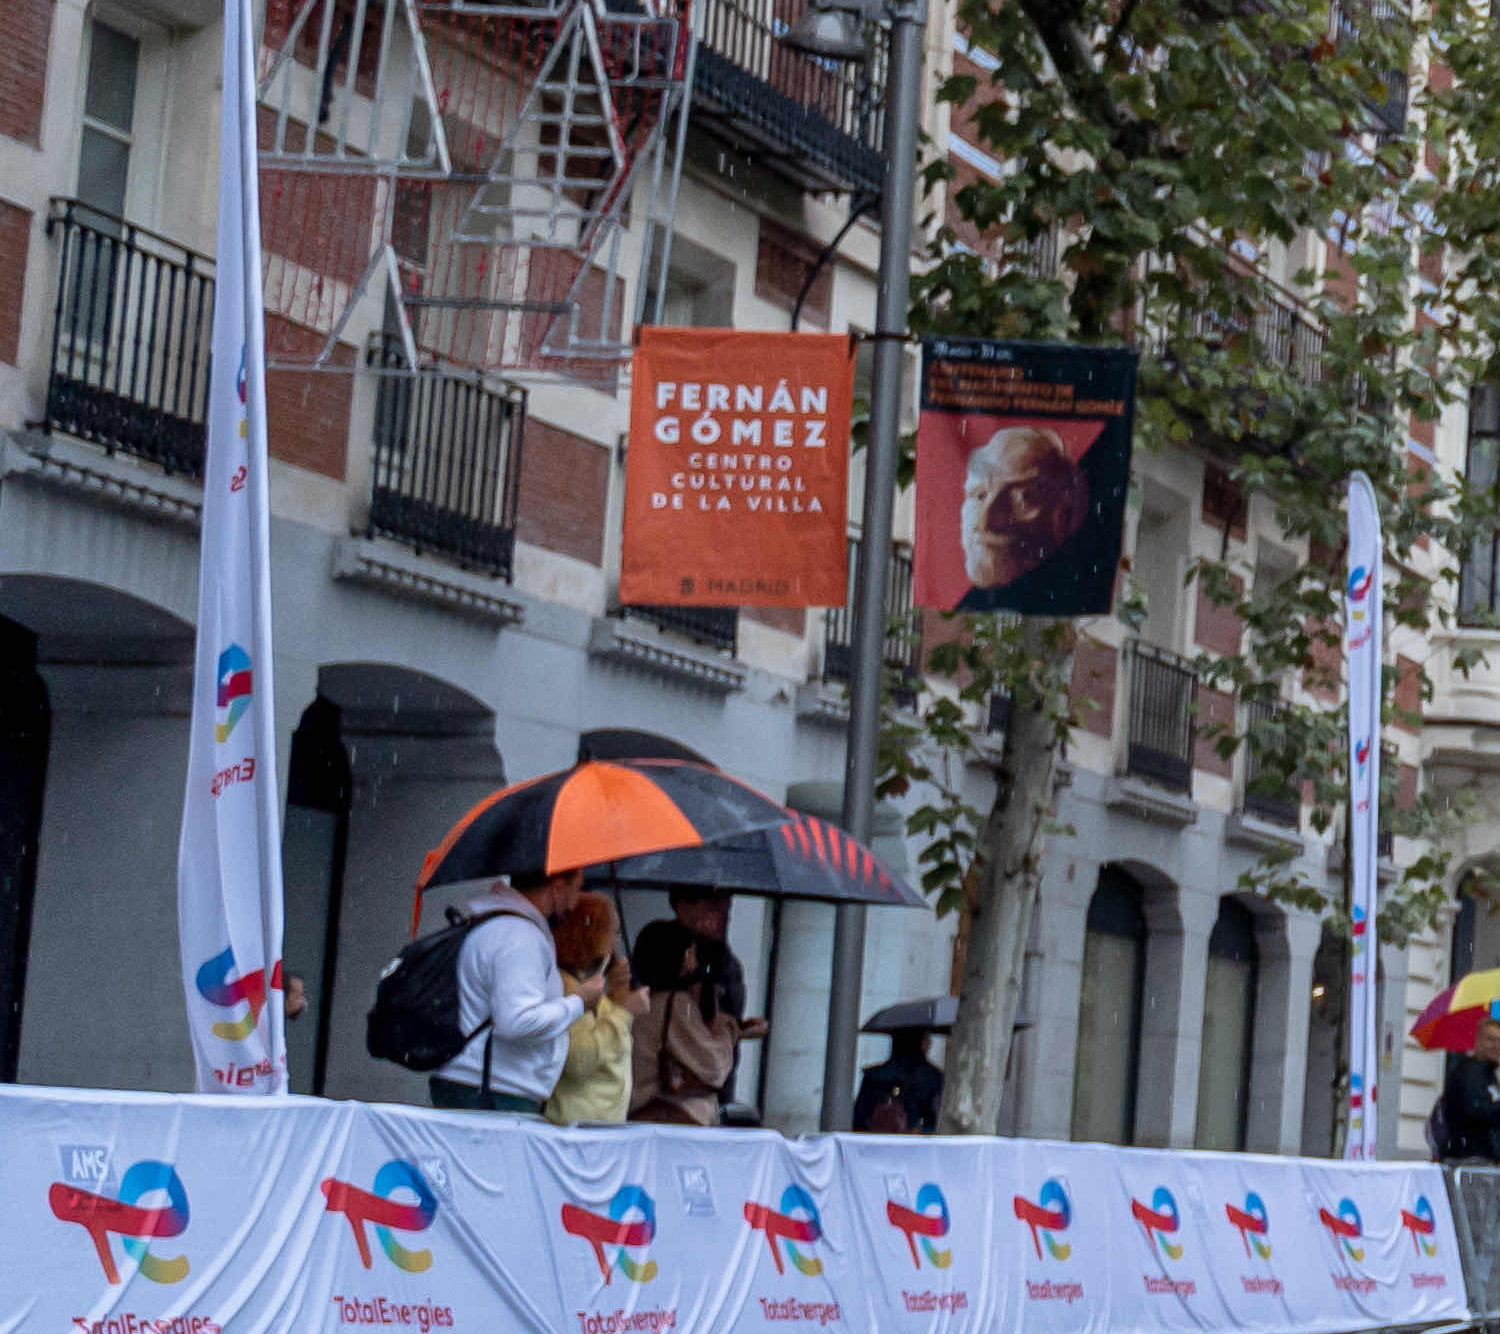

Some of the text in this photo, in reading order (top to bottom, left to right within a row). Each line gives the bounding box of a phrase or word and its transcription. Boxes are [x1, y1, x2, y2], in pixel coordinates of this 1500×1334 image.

[656, 379, 828, 415] FERNÁN
[654, 411, 827, 448] GÓMEZ
[688, 452, 793, 472] CENTRO
[671, 472, 806, 492] CULTURAL
[652, 493, 823, 513] DE LA VILLA
[333, 1295, 454, 1334] TotalEnergies
